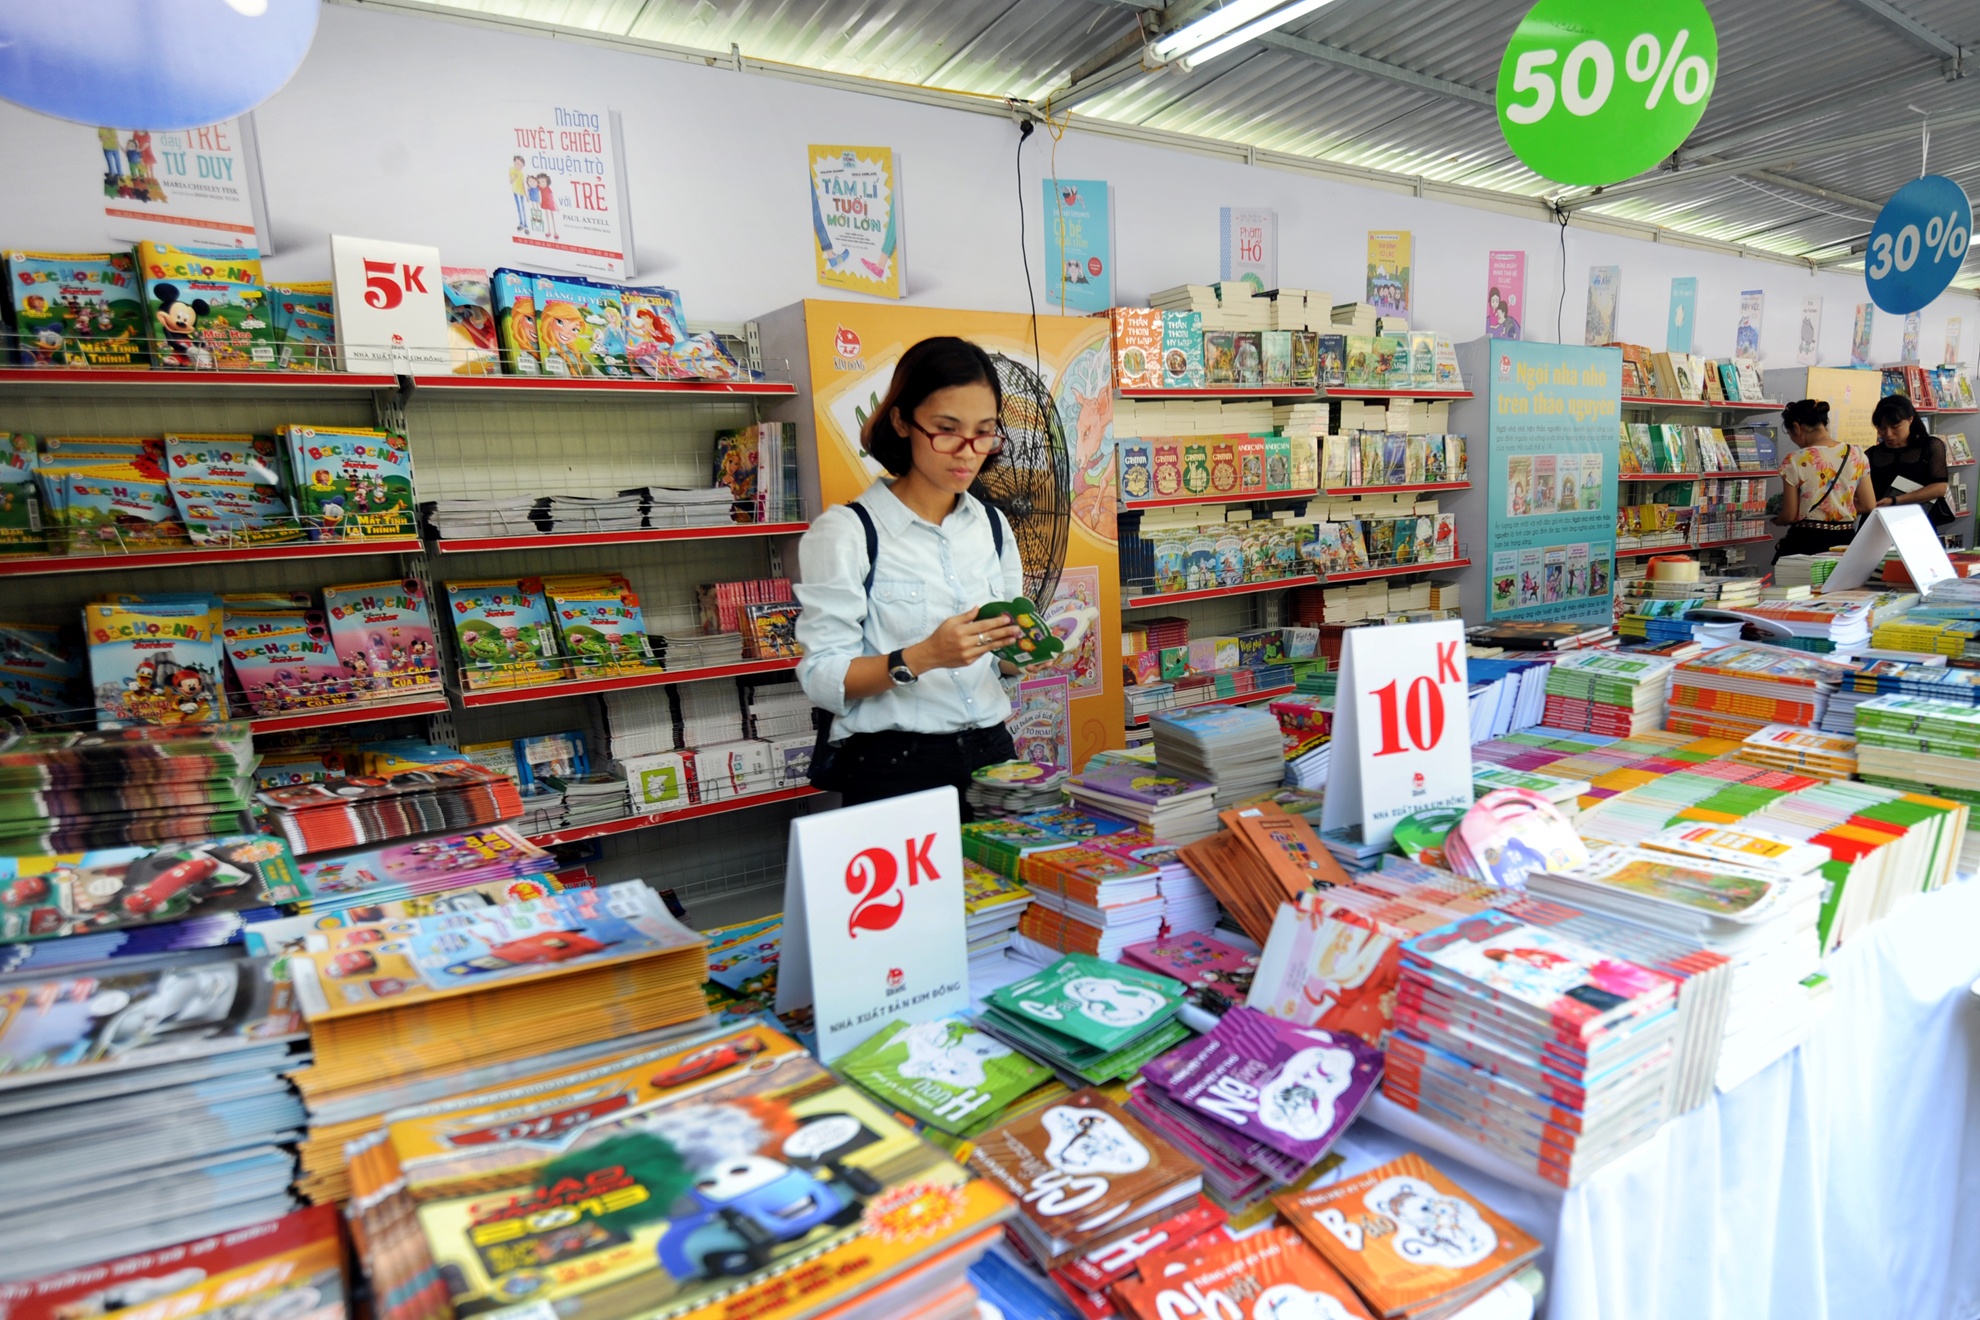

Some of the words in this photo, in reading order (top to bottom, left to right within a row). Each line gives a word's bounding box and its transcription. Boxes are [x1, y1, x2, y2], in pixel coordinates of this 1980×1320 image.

[1506, 29, 1710, 125] 50%
[553, 106, 600, 132] Những
[162, 151, 187, 176] TƯ
[196, 154, 233, 181] DUY
[532, 152, 583, 178] chuyện
[584, 157, 604, 176] trò
[163, 180, 187, 190] MARIA
[222, 187, 239, 196] FISK
[570, 176, 608, 212] TRẺ
[822, 175, 857, 196] TÂM
[863, 178, 879, 199] LÍ
[832, 194, 868, 217] TUỔI
[562, 214, 580, 224] PAUL
[826, 212, 850, 228] MỚI
[853, 215, 881, 232] LỚN
[1868, 210, 1968, 282] 30%
[363, 257, 428, 310] 5K
[757, 616, 786, 627] BATMAN
[1369, 641, 1461, 757] 10K
[845, 832, 941, 939] 2K
